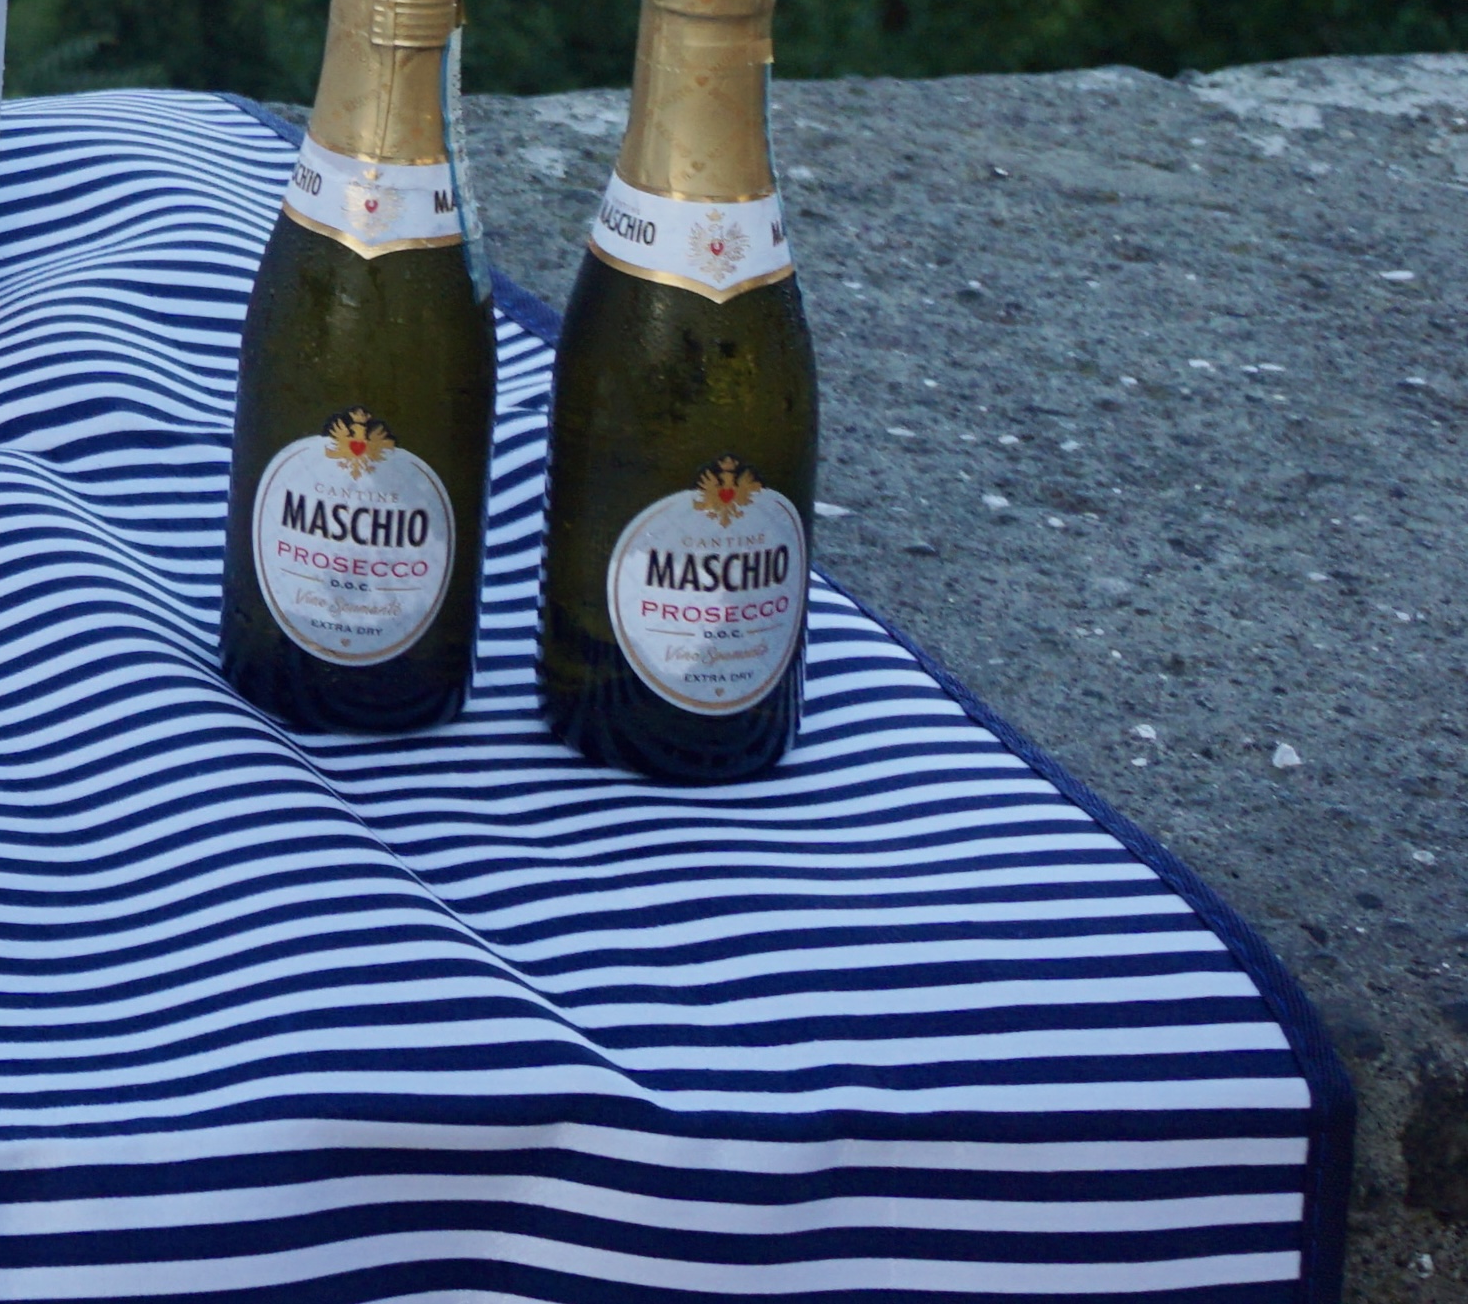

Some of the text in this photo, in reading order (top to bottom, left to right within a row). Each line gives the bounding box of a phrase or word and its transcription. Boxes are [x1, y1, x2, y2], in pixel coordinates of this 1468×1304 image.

[315, 482, 400, 504] CANTINE
[281, 489, 430, 548] MASCHIO
[681, 533, 765, 548] CANTINE
[277, 540, 429, 578] PROSECCO
[645, 543, 789, 592] MASCHIO
[330, 579, 371, 592] D.O.C.
[641, 596, 789, 623] PROSECCO
[311, 619, 383, 636] EXTRA DRY
[703, 629, 744, 639] D.O.C.
[685, 671, 754, 682] EXTRA DRY
